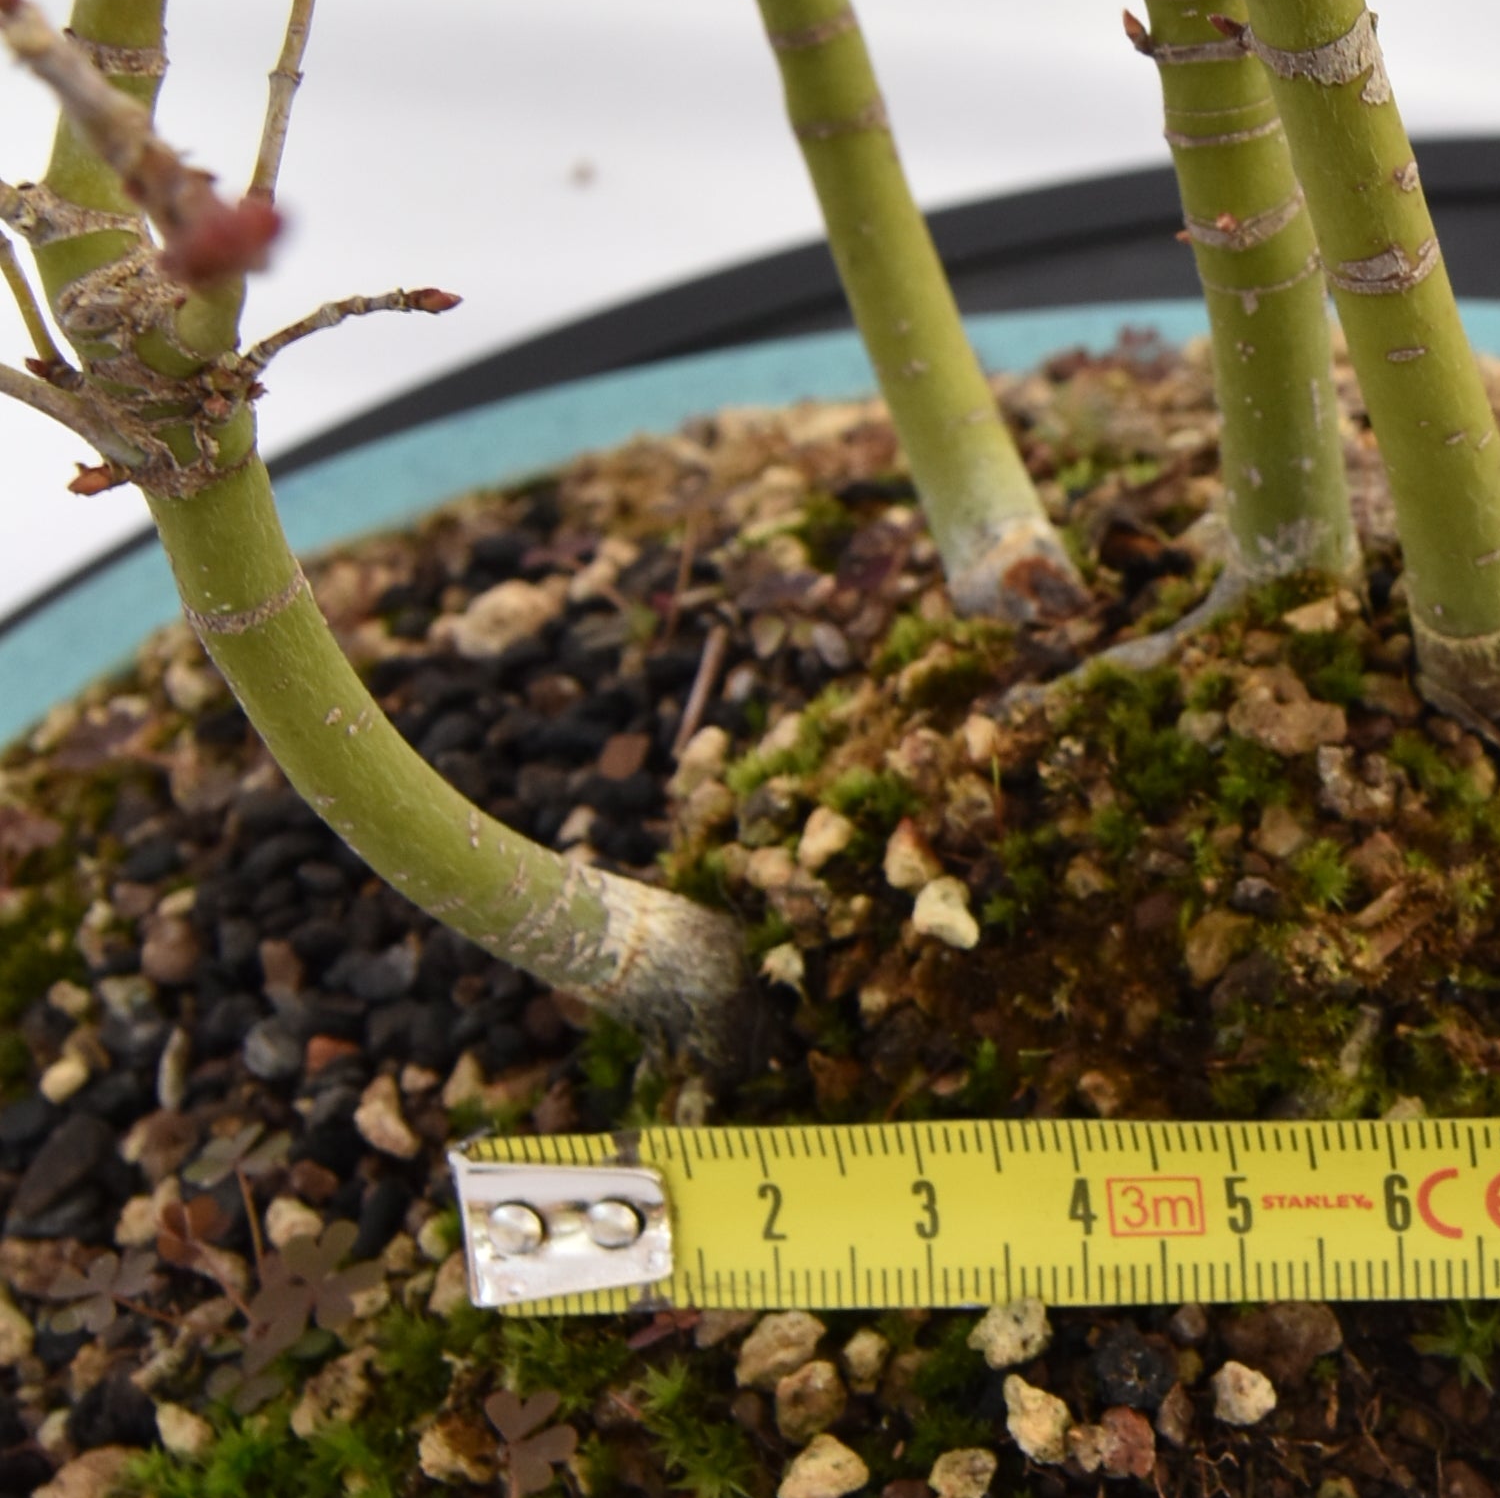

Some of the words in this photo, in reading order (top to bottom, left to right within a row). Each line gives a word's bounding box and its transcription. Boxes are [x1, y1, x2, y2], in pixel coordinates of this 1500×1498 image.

[755, 1181, 790, 1243] 2
[908, 1177, 943, 1241] 3
[1065, 1175, 1099, 1237] 4
[1118, 1183, 1198, 1229] 3m
[1222, 1175, 1255, 1236] 5
[1382, 1173, 1413, 1233] 6
